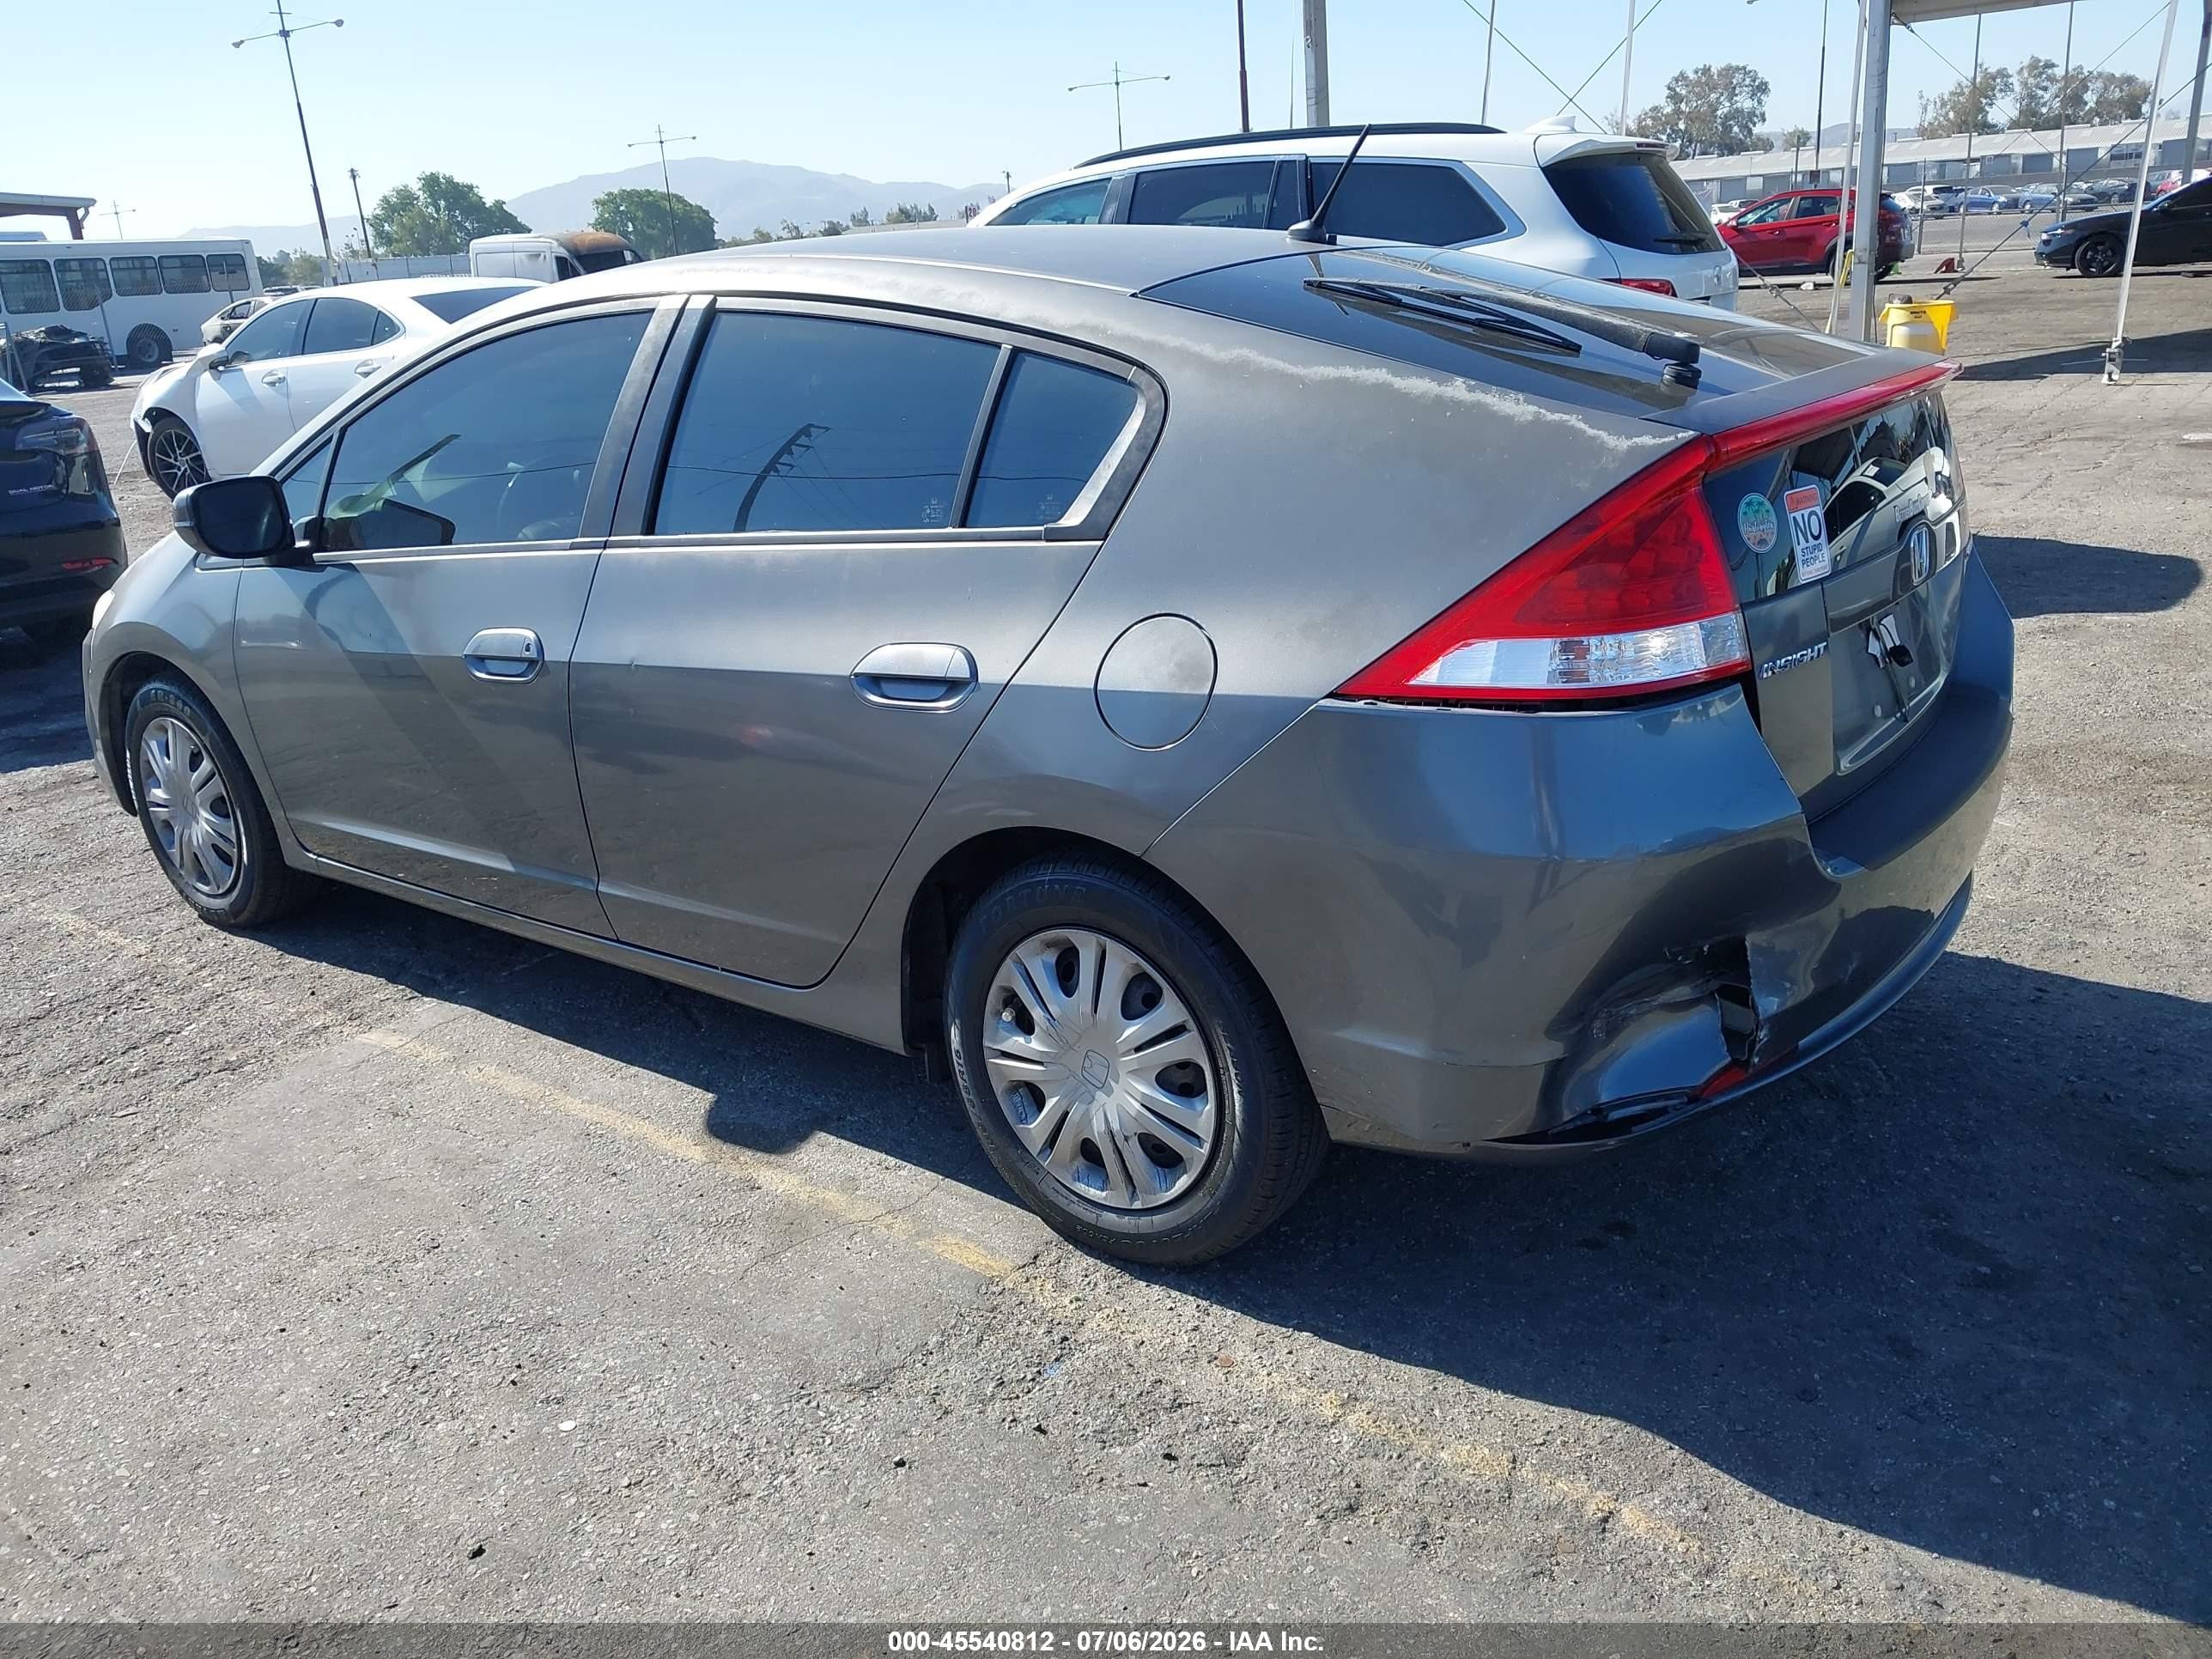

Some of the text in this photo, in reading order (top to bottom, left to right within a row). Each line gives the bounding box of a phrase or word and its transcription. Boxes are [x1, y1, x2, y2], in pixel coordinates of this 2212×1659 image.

[29, 483, 53, 492] MOTOR
[1792, 510, 1822, 546] NO
[1801, 543, 1823, 557] STUPID
[1802, 553, 1826, 568] PEOPLE
[1760, 641, 1828, 679] INSIGHT
